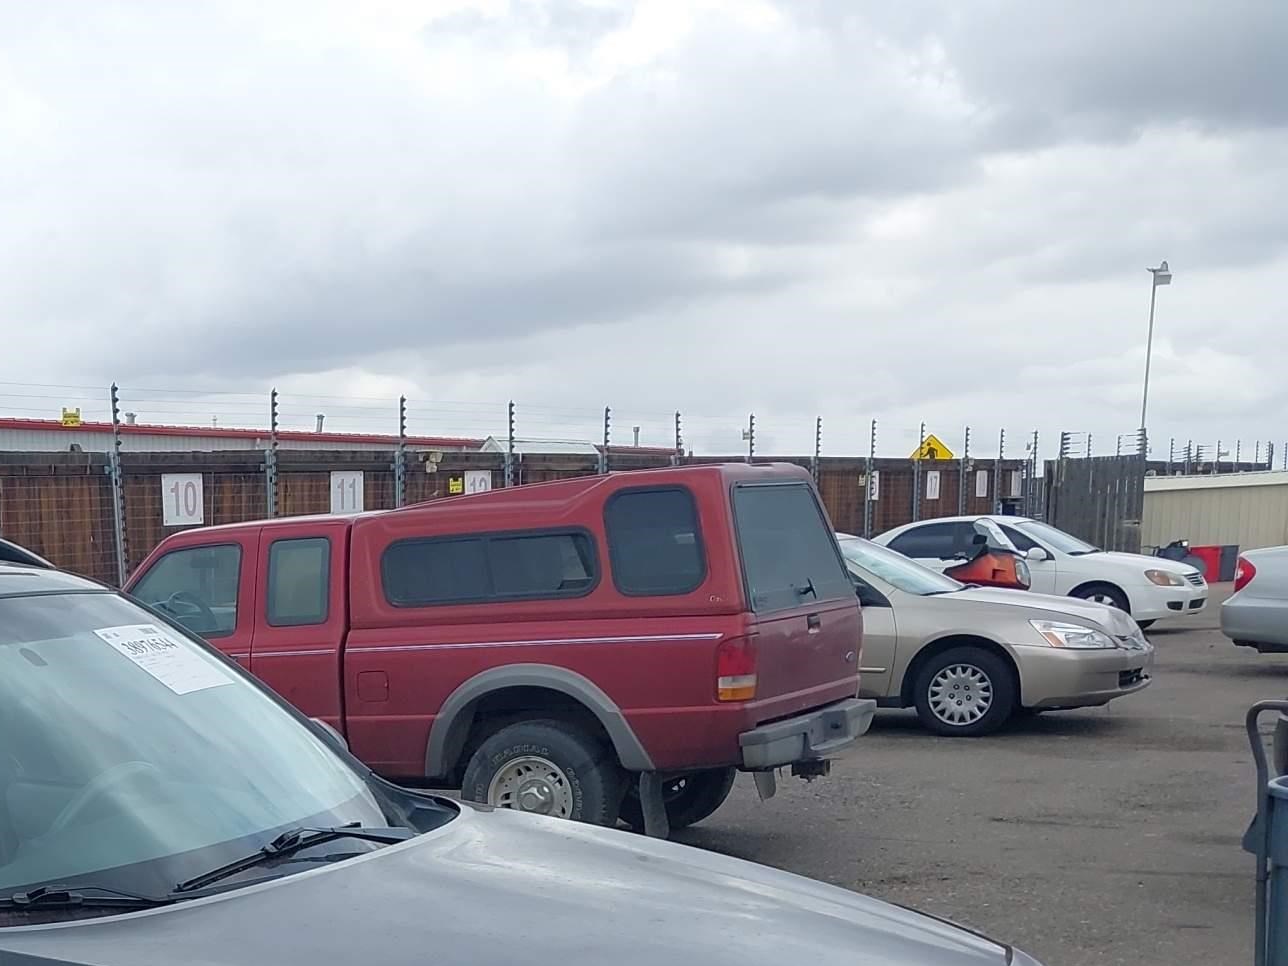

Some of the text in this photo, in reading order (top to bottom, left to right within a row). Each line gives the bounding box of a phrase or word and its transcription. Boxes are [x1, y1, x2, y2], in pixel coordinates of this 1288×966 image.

[170, 481, 196, 516] 10
[337, 478, 355, 510] 11
[121, 637, 178, 656] 38976544
